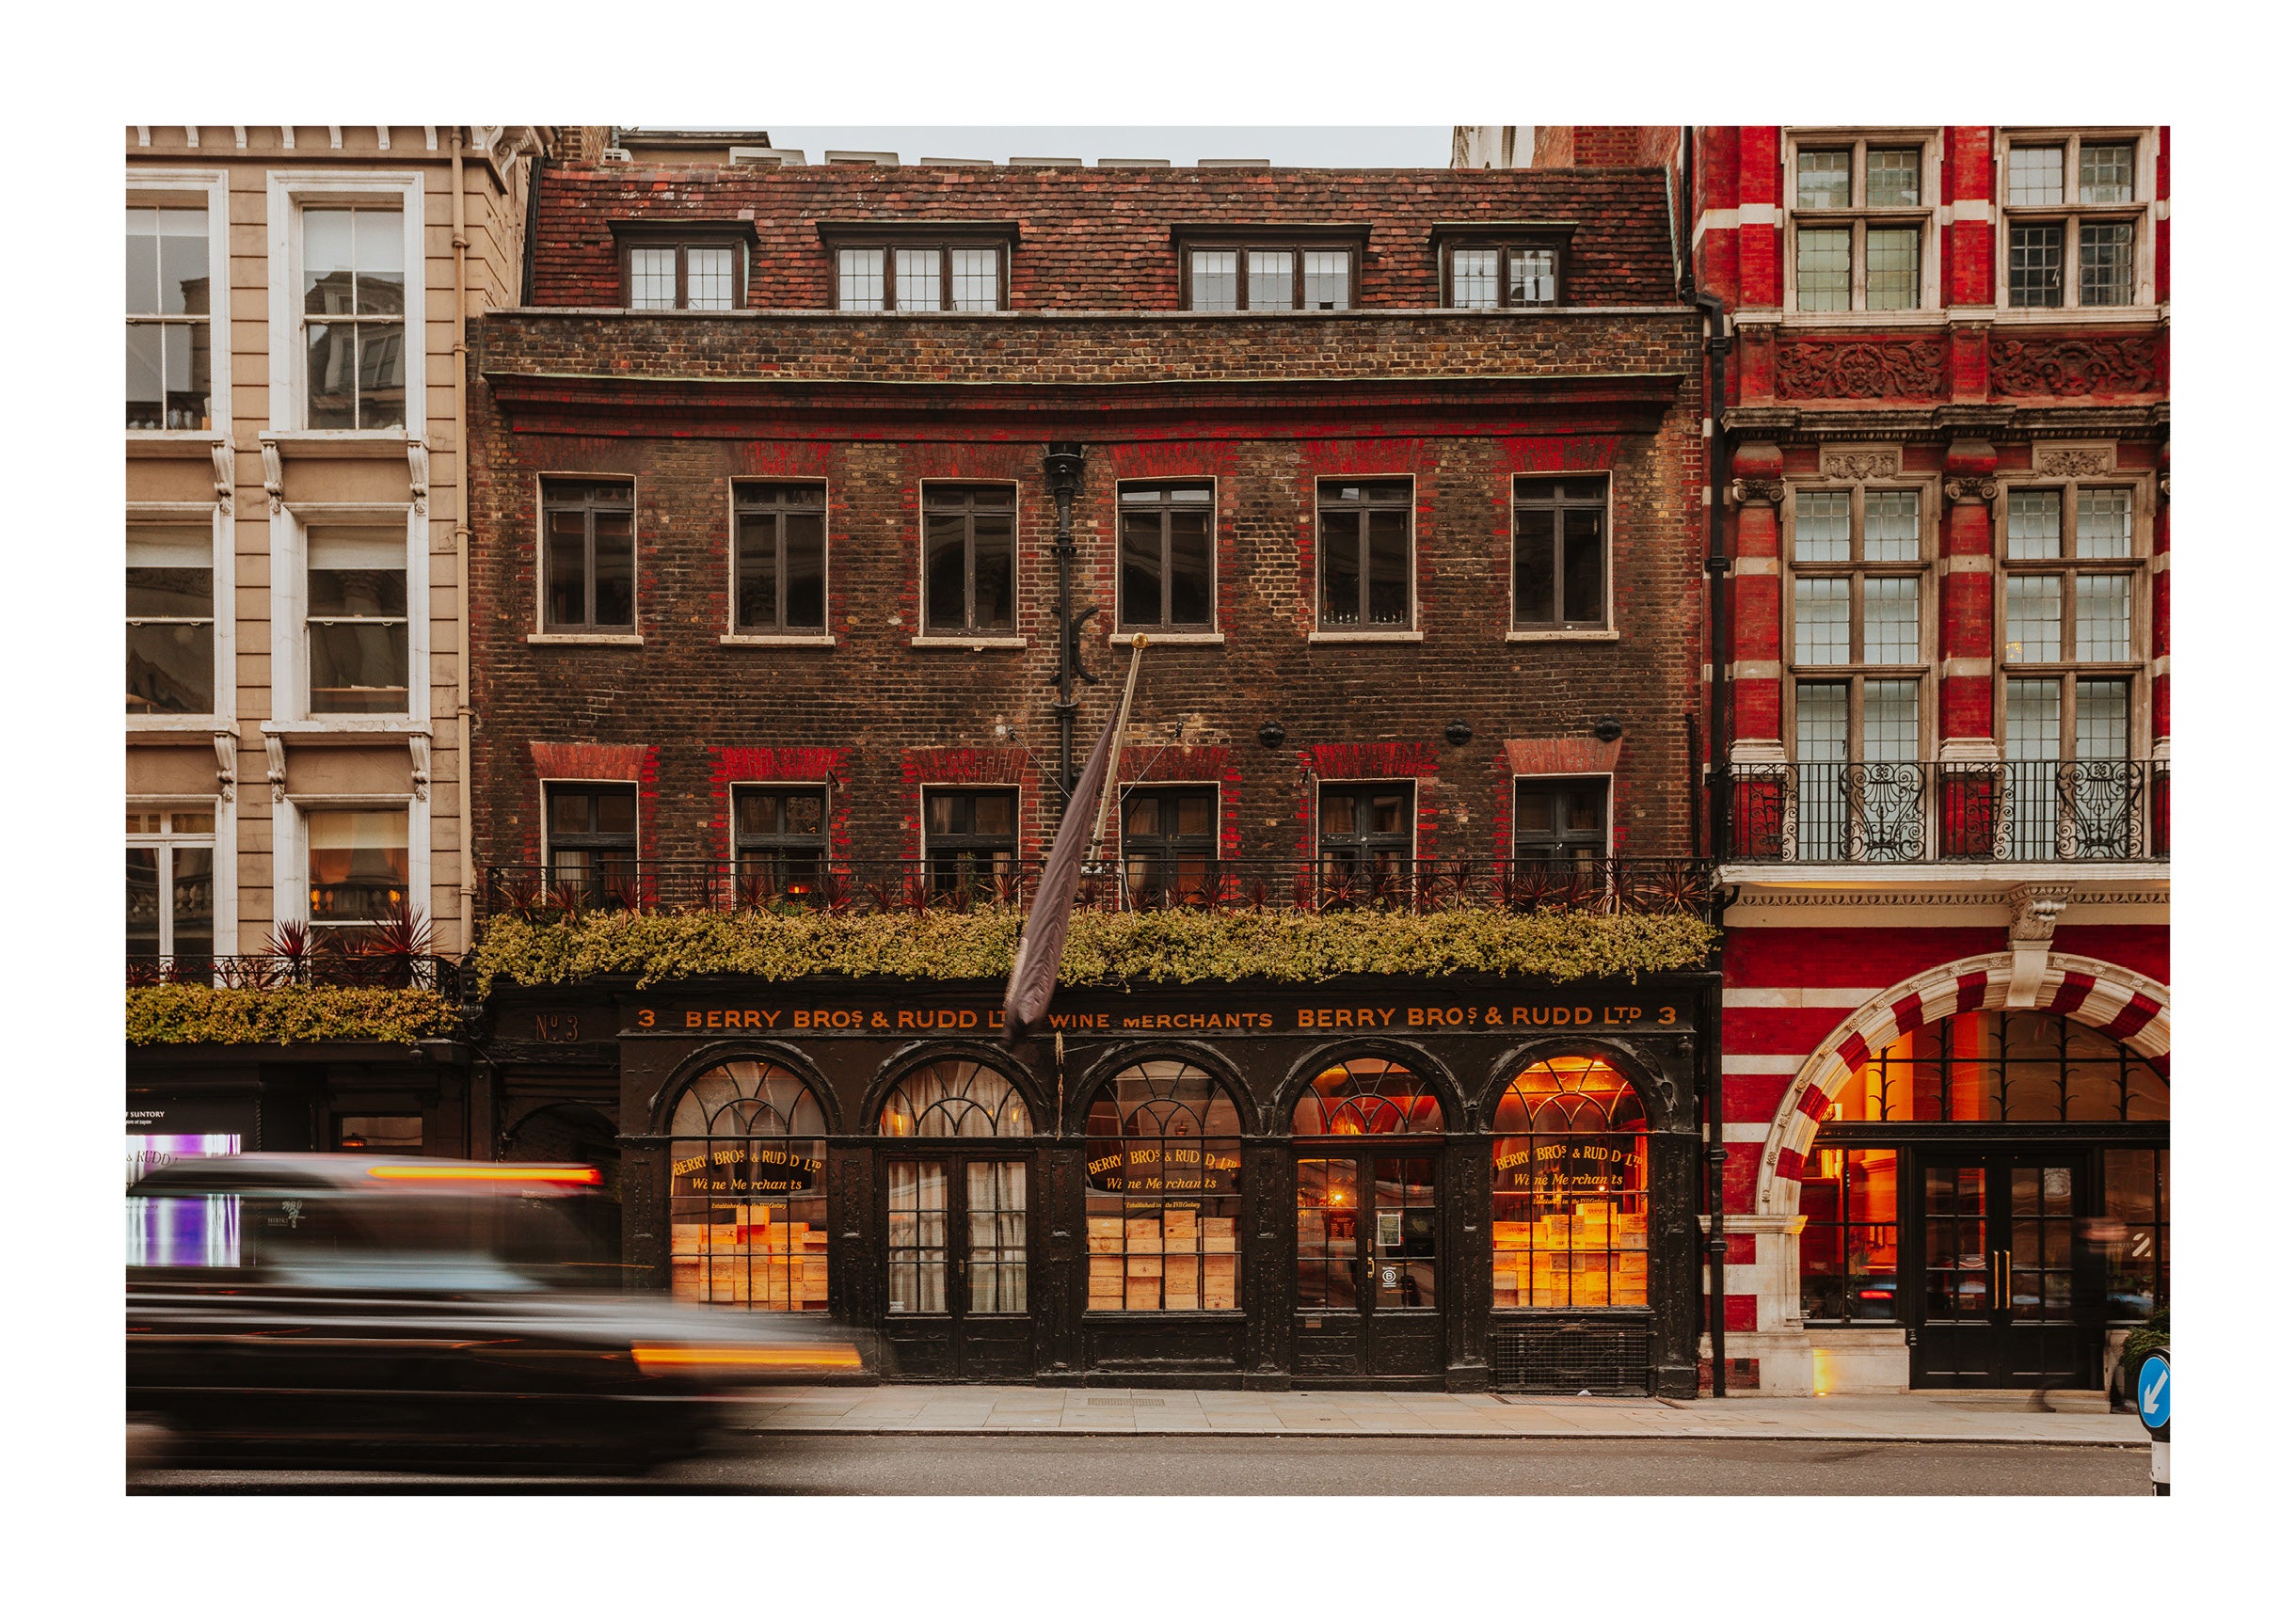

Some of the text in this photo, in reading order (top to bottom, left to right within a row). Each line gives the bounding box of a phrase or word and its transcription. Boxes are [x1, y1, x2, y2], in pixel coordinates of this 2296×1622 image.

[637, 1009, 656, 1027] 3
[686, 1010, 782, 1028] BERRY
[870, 1010, 889, 1028] &
[898, 1010, 978, 1028] RUDD
[1048, 1012, 1273, 1028] WINE MERCHANTS
[1298, 1008, 1396, 1027] BERRY
[1484, 1007, 1504, 1025] &
[1513, 1007, 1593, 1026] RUDD
[1657, 1007, 1677, 1025] 3
[566, 1015, 578, 1042] 3
[136, 1150, 171, 1167] RUDD
[673, 1154, 707, 1176] BERRY
[751, 1153, 758, 1163] &
[762, 1150, 800, 1167] RUDD
[1088, 1153, 1123, 1175] BERRY
[1164, 1152, 1172, 1162] &
[1175, 1149, 1215, 1167] RUDD
[1495, 1150, 1530, 1171] BERRY
[1572, 1148, 1581, 1159] &
[1583, 1145, 1621, 1163] RUDD
[693, 1178, 802, 1190] Wine Merchants
[1107, 1177, 1217, 1189] Wine Merchants
[1514, 1173, 1623, 1185] Wine Merchants
